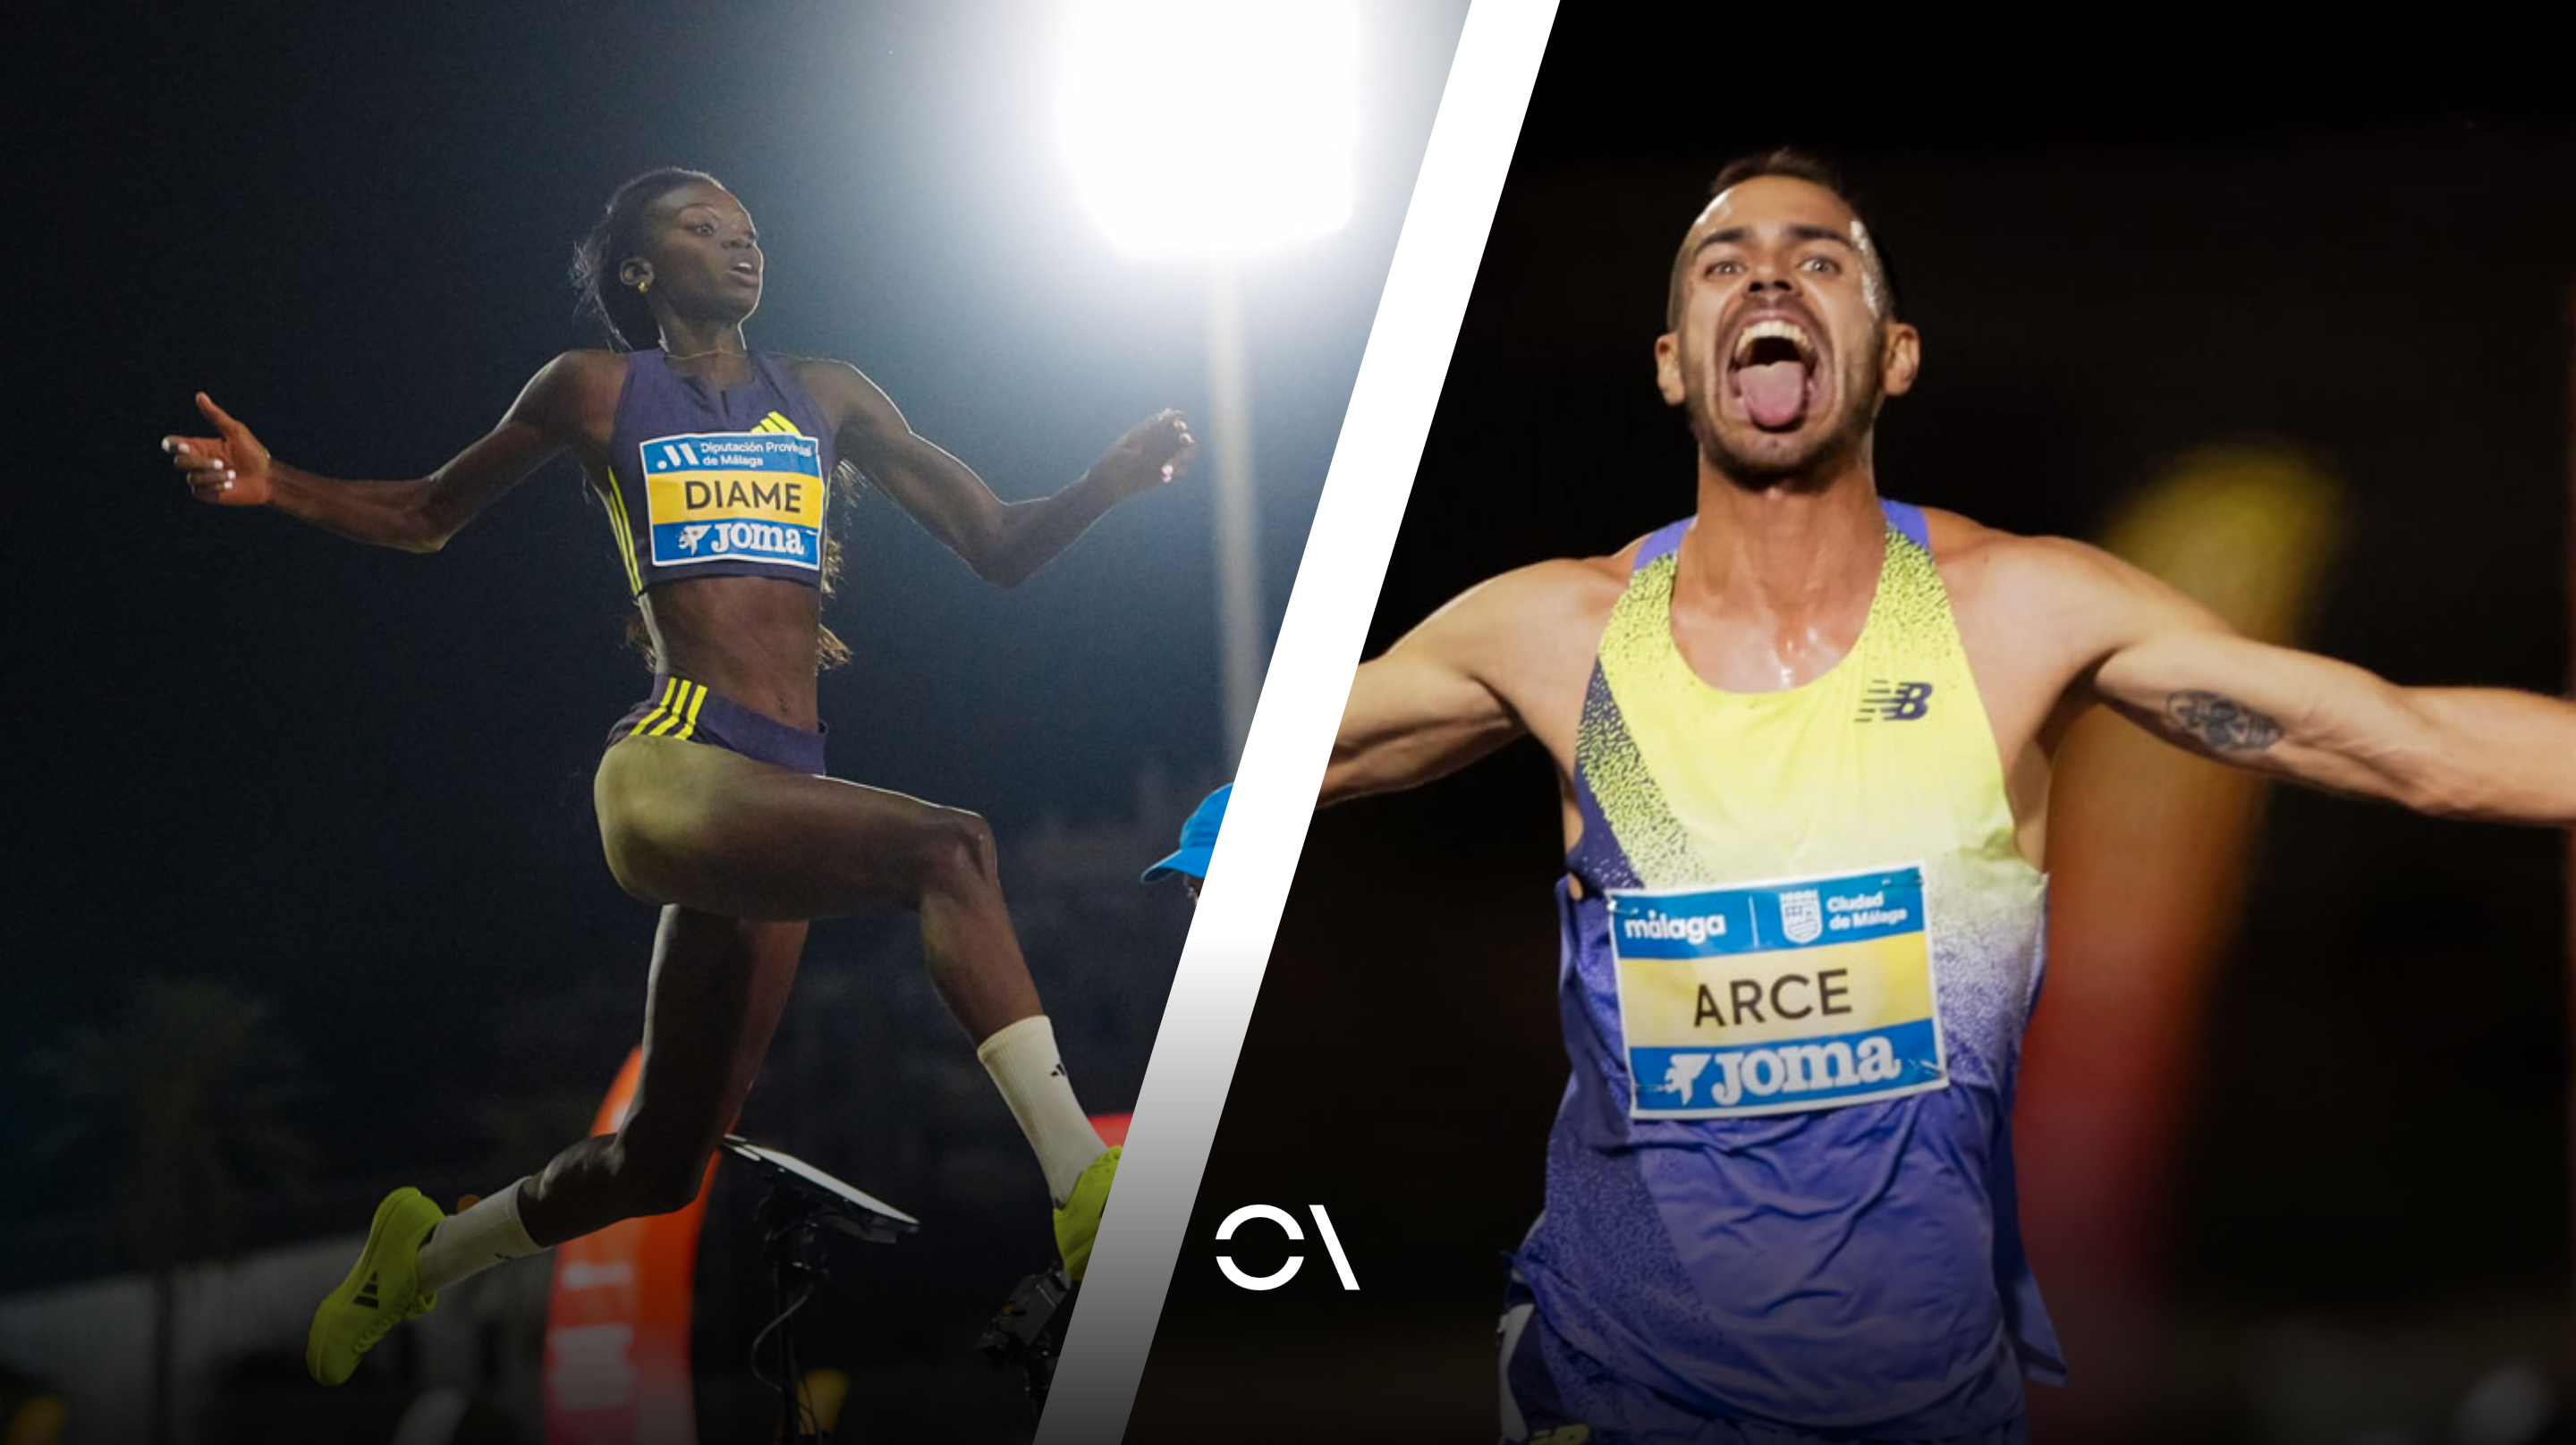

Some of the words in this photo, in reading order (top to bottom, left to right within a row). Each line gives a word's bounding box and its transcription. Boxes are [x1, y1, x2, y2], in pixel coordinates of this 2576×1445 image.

[700, 442, 764, 453] Diputación
[703, 456, 718, 466] de
[720, 454, 764, 468] Málaga
[684, 480, 801, 513] DIAME
[1826, 891, 1884, 912] Ciudad
[1829, 914, 1851, 930] de
[1852, 908, 1907, 927] Málaga
[1693, 968, 1853, 1027] ARCE
